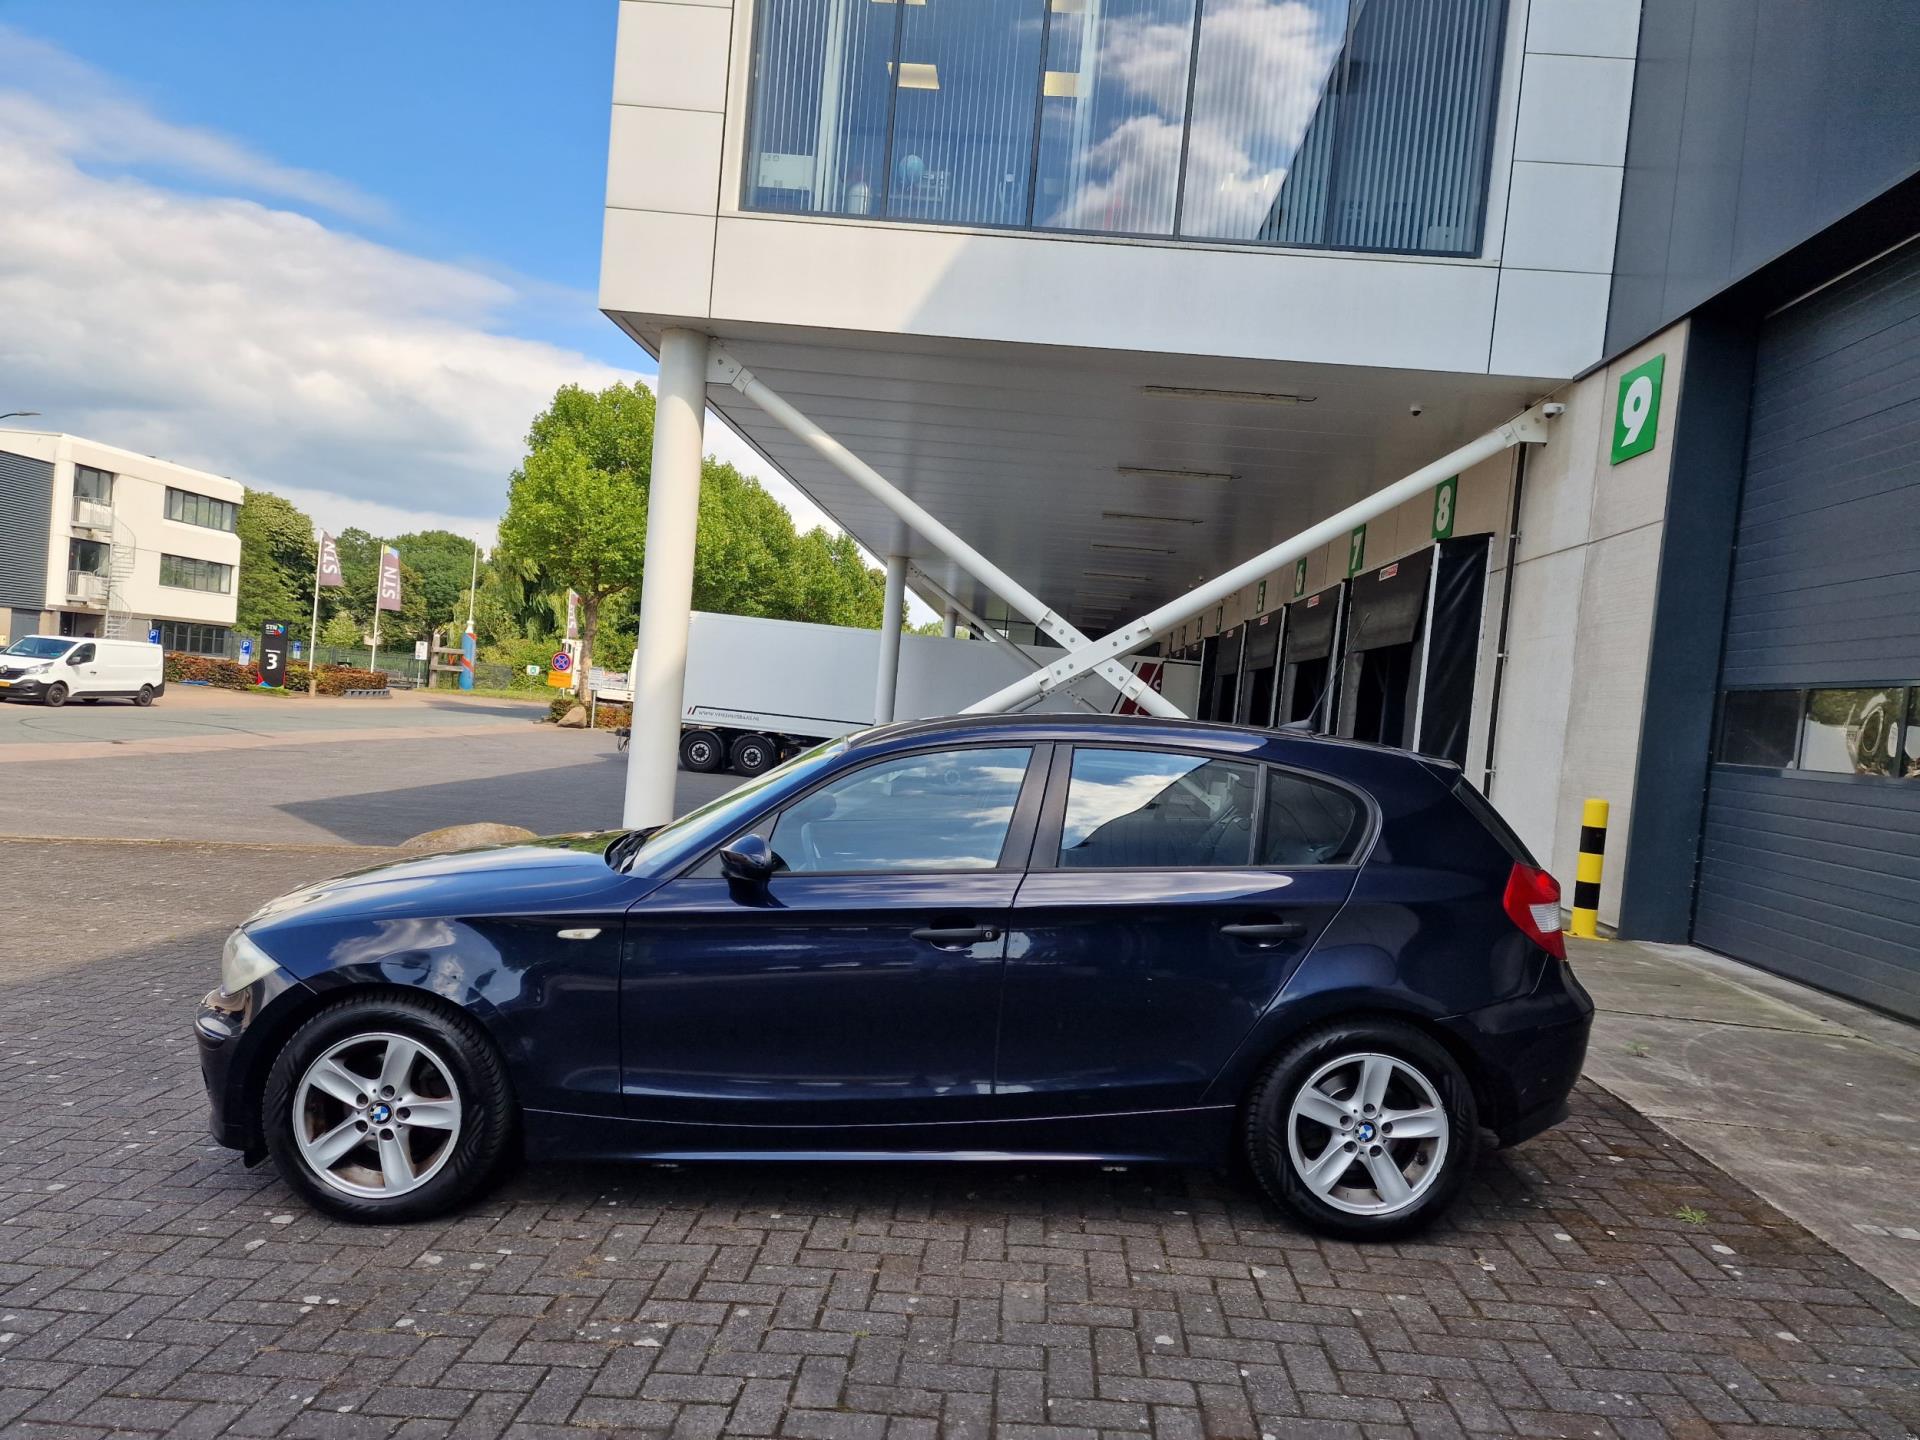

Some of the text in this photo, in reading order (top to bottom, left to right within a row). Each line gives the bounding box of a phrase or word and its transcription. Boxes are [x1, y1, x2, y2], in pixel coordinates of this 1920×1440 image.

[1620, 376, 1653, 448] 9
[1436, 485, 1452, 532] 8
[323, 540, 338, 574] STN
[1351, 532, 1363, 570] 7
[381, 566, 398, 600] STN
[266, 653, 278, 670] 3
